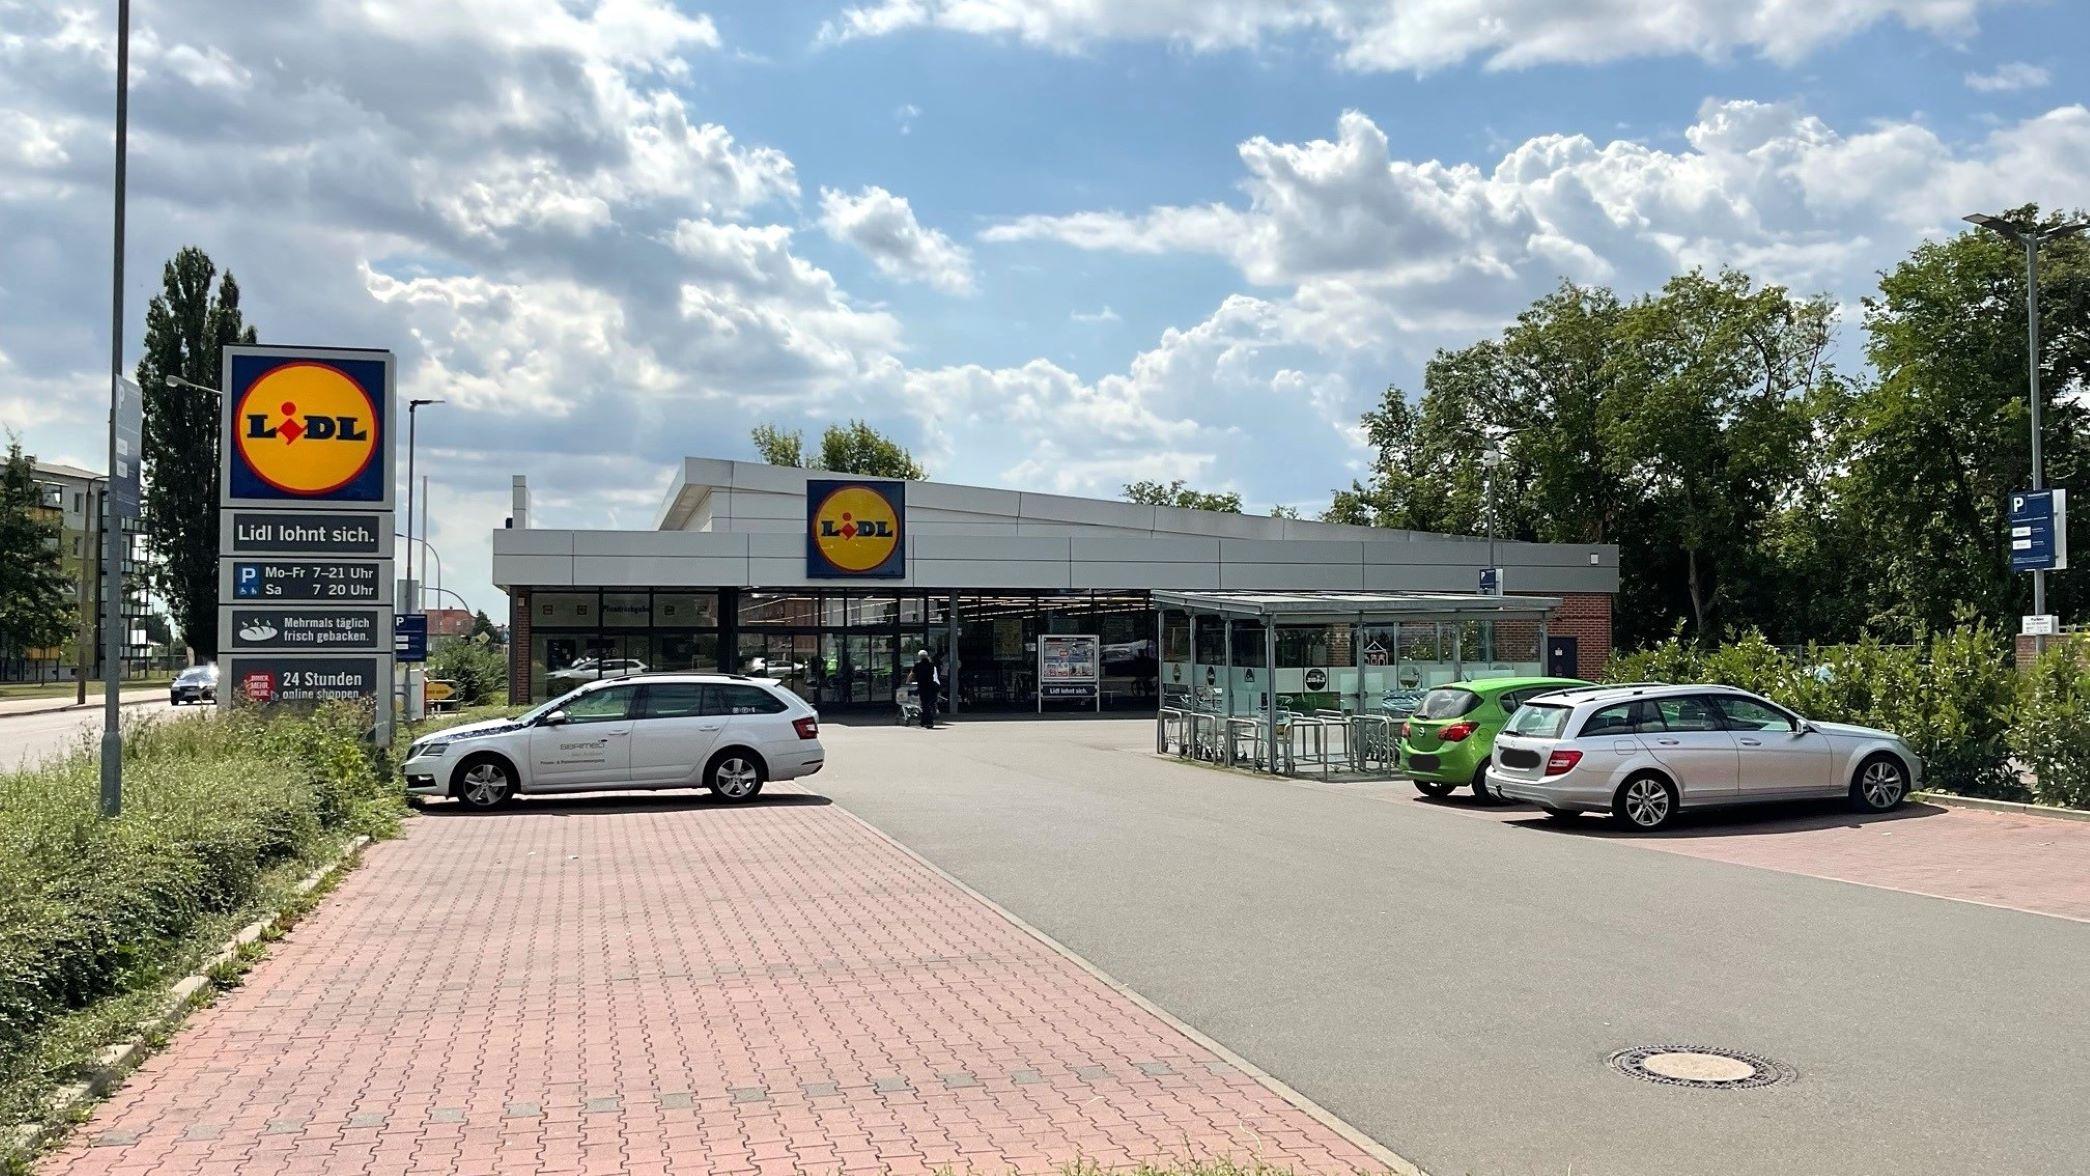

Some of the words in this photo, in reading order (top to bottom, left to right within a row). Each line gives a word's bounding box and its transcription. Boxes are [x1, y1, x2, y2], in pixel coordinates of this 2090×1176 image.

[2013, 497, 2024, 512] P
[238, 524, 272, 541] Lidl
[279, 525, 326, 542] lohnt
[332, 526, 375, 543] sich.
[241, 567, 256, 583] P
[350, 567, 374, 579] Uhr
[265, 584, 282, 596] Sa
[350, 584, 374, 596] Uhr
[284, 617, 334, 628] Mehrmals
[336, 617, 370, 630] täglich
[396, 616, 405, 627] P
[284, 630, 314, 641] frisch
[316, 631, 370, 644] gebacken.
[283, 672, 300, 687] 24
[304, 672, 362, 686] Stunden
[282, 689, 314, 700] online
